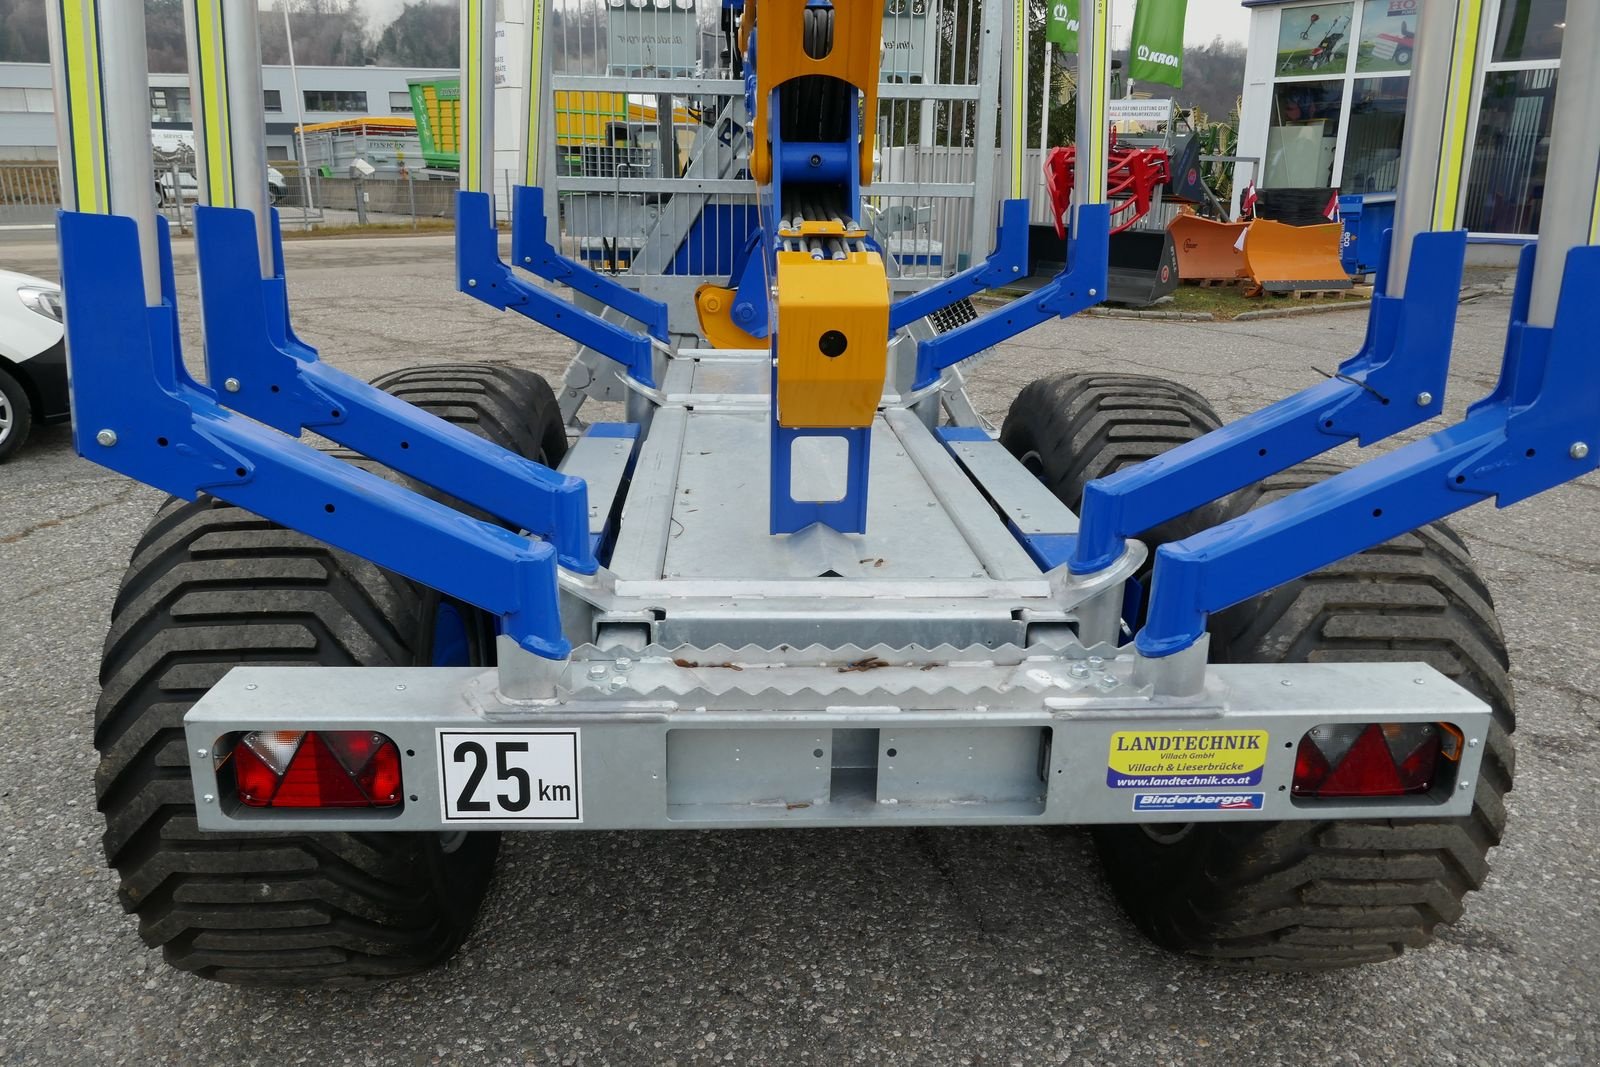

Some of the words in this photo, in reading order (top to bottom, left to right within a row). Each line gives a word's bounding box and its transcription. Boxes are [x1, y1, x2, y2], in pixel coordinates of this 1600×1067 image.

[1116, 735, 1261, 751] LANDTECHNIK
[1189, 752, 1216, 760] GmbH
[1128, 763, 1163, 772] Villach
[1165, 763, 1175, 772] &
[1176, 762, 1244, 771] Lieserbrücke
[453, 741, 531, 812] 25
[538, 779, 571, 801] km
[1116, 776, 1250, 786] www.landtechnik.co.at
[1140, 795, 1252, 805] Binderberger
